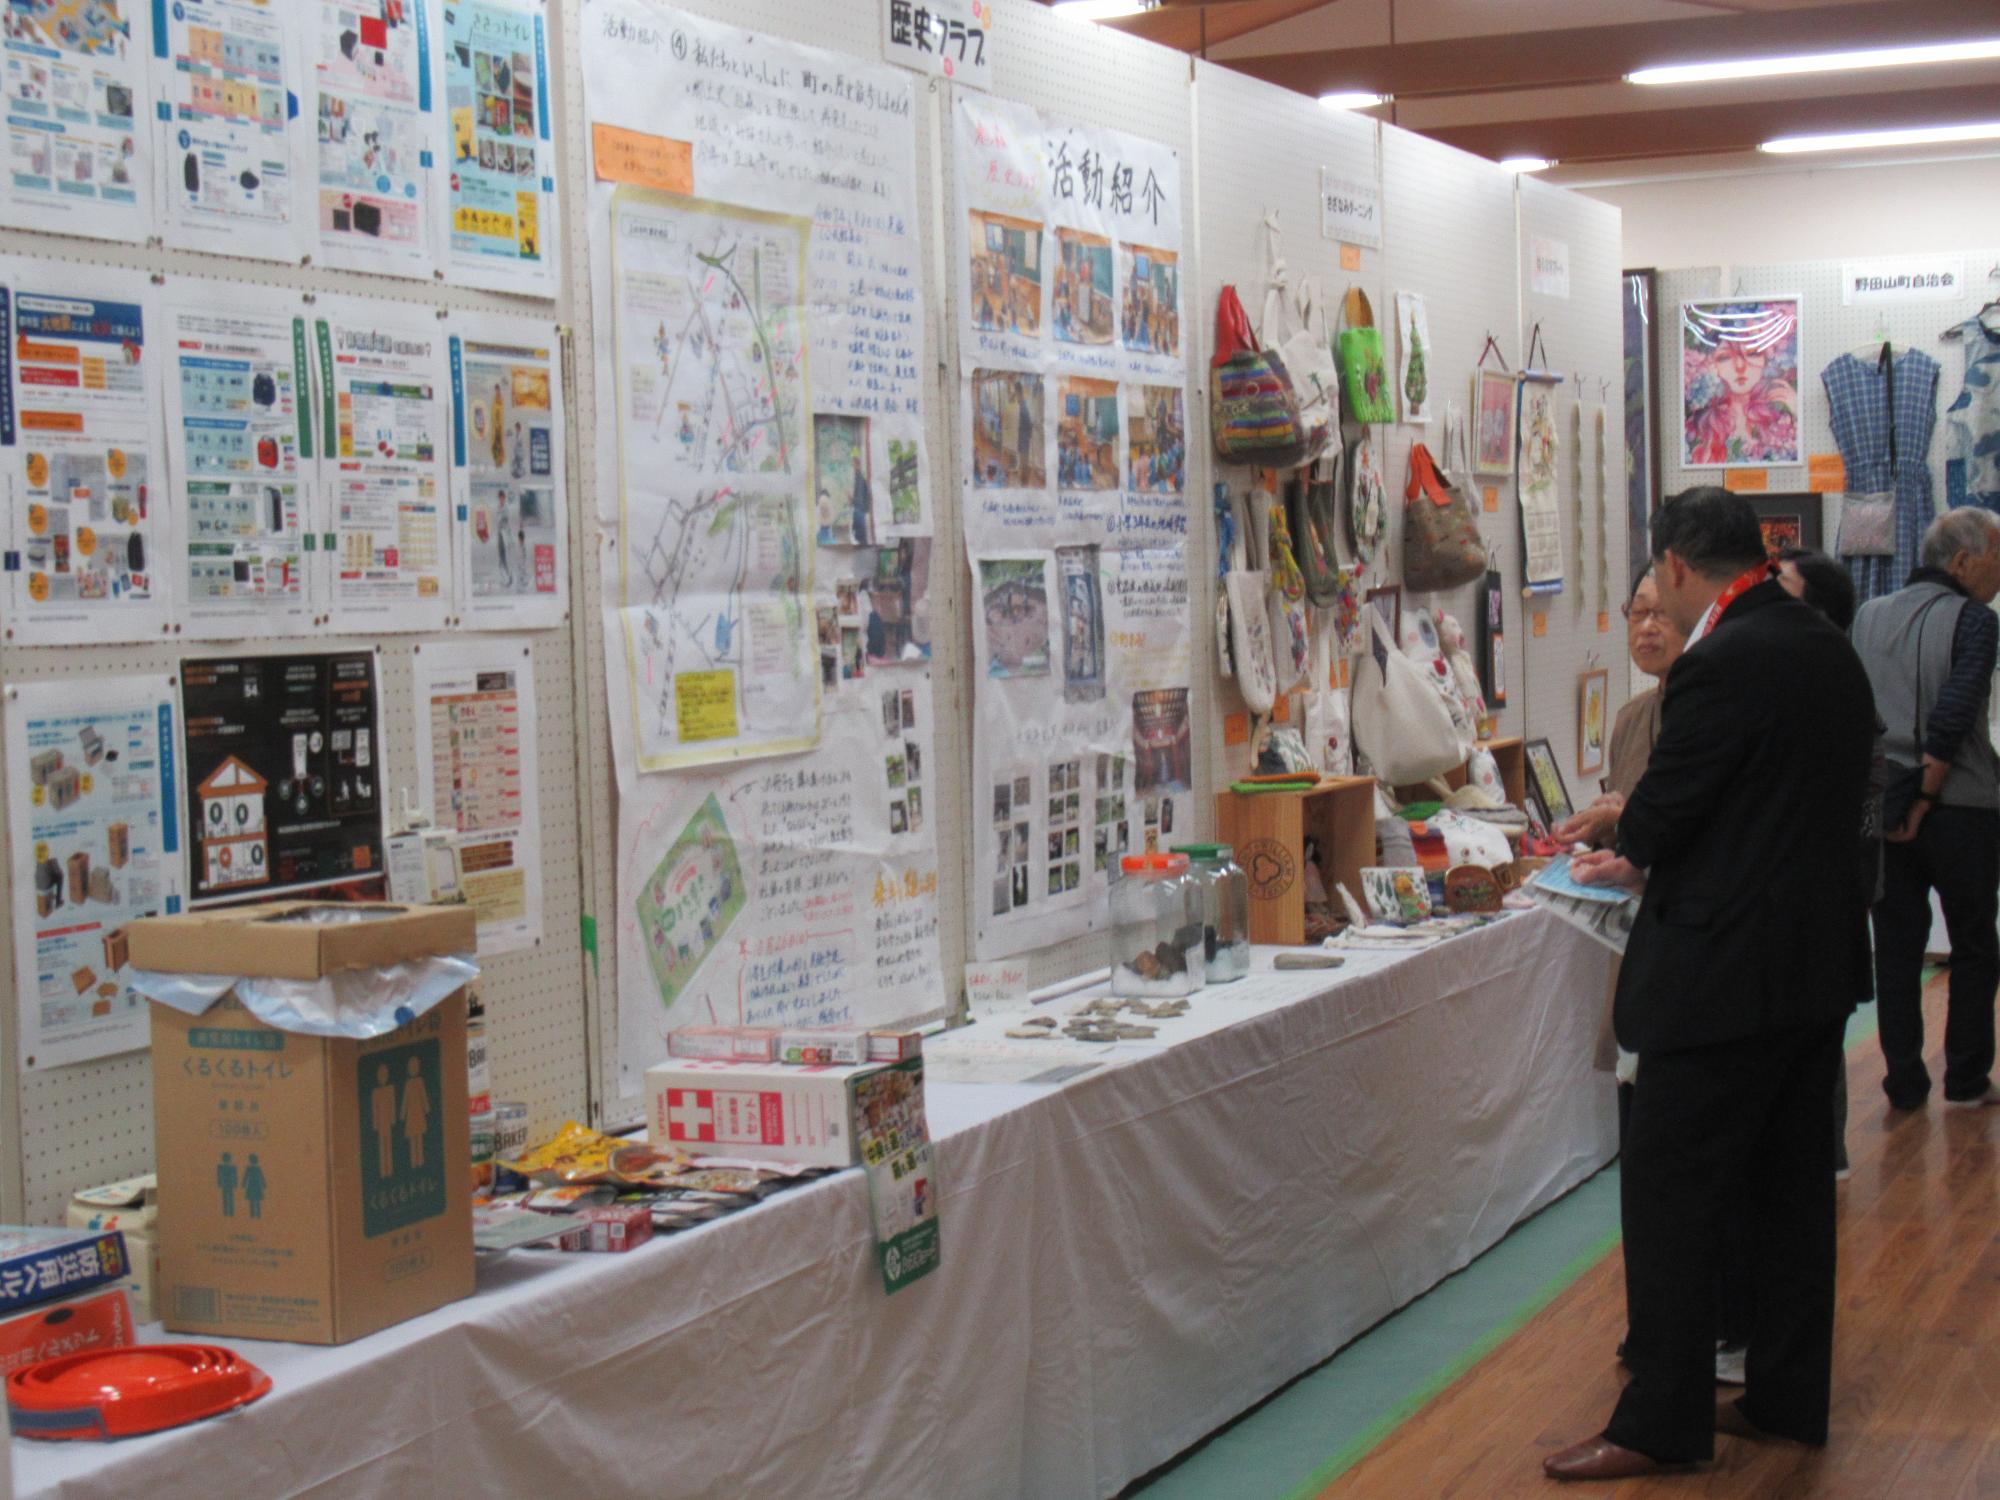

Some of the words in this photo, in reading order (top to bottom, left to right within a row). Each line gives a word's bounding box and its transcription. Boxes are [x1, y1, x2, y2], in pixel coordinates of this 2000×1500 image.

[891, 0, 985, 66] 歴史クラブ
[1049, 141, 1166, 226] 活動紹介
[1855, 272, 1954, 292] 野田山町自治会
[182, 1057, 295, 1080] くるくるトイレ
[0, 1244, 99, 1299] 防災用ヘル
